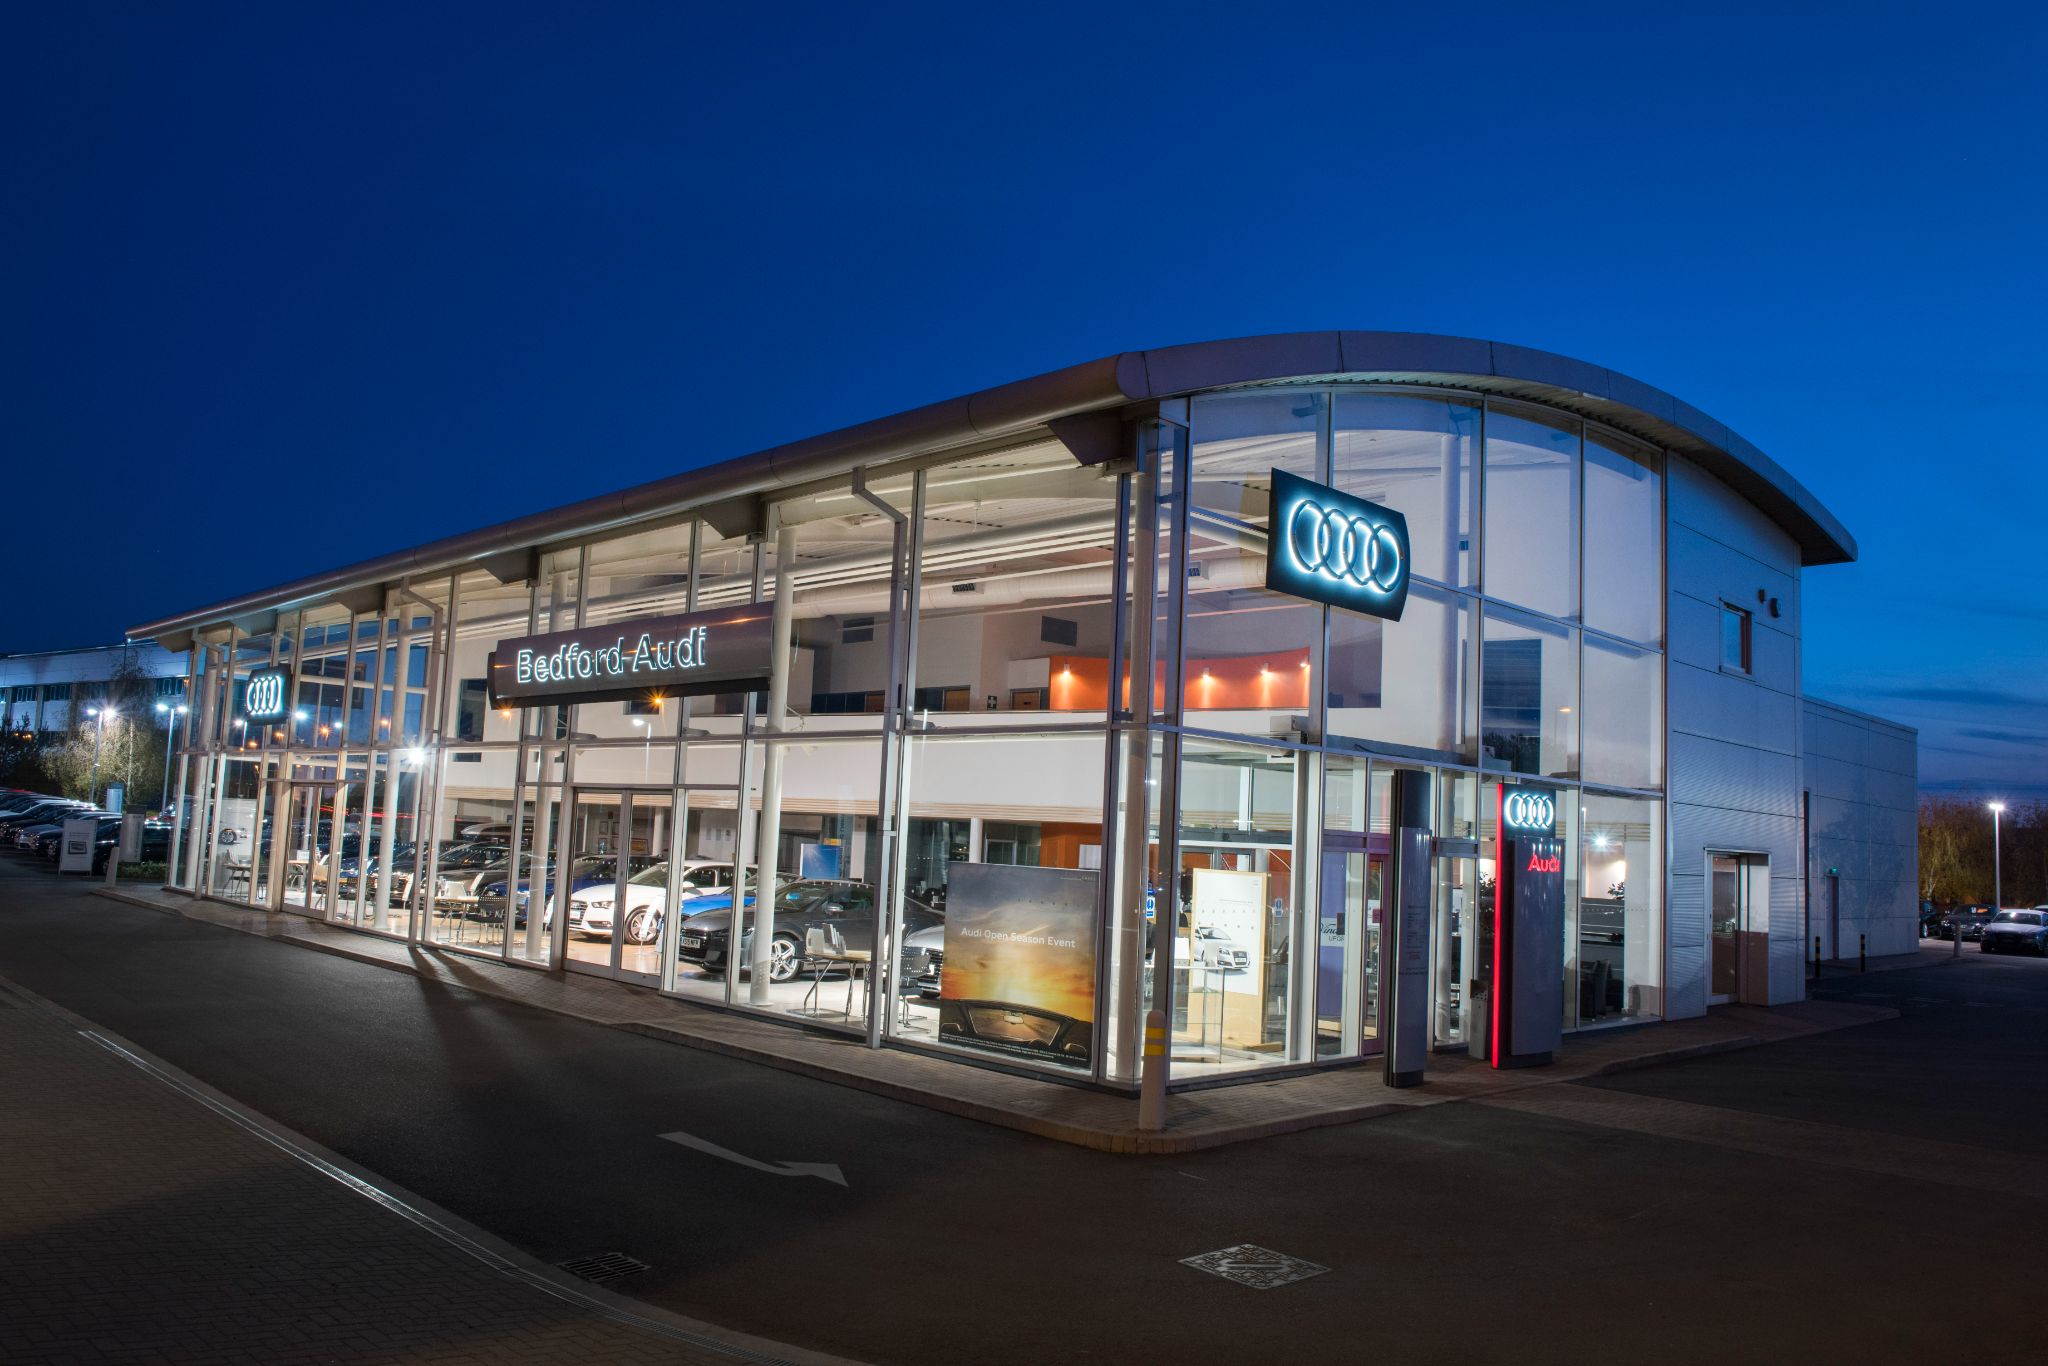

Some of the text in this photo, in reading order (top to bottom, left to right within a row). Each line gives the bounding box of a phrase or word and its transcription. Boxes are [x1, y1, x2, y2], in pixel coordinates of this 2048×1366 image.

[517, 626, 707, 684] Bedford Audi
[1527, 853, 1560, 873] Audi
[960, 927, 1076, 948] Audi Open Season Event
